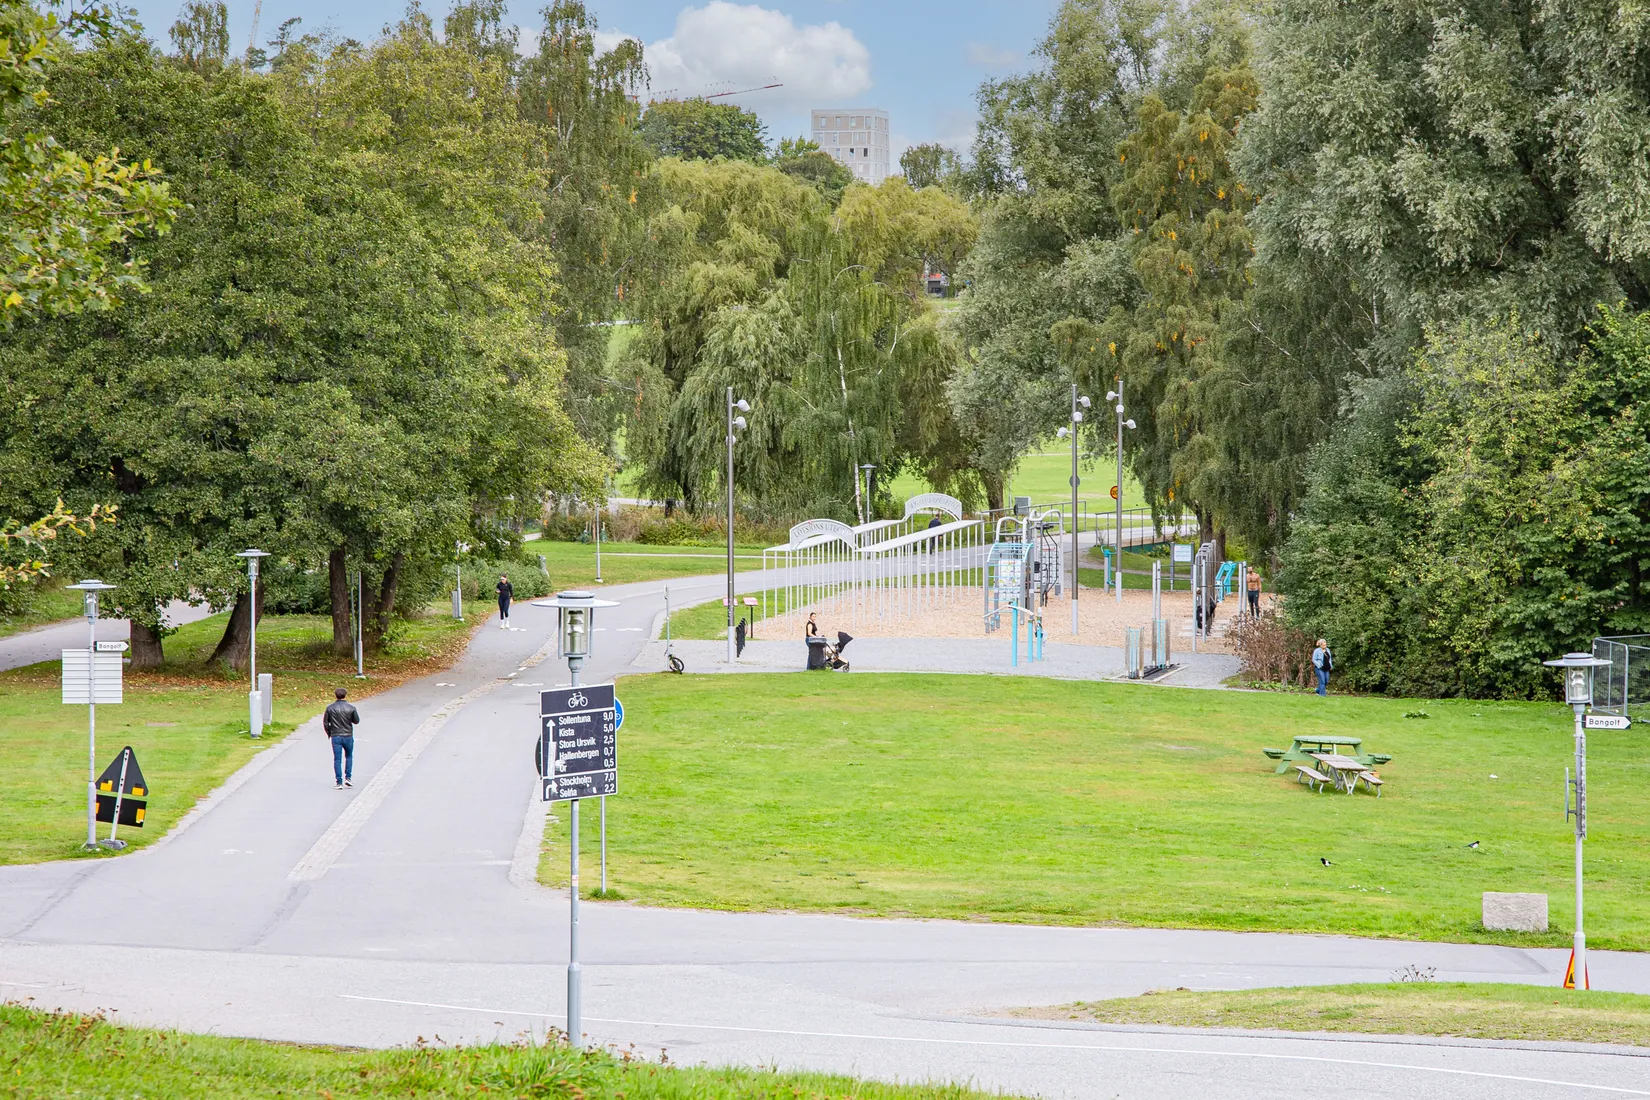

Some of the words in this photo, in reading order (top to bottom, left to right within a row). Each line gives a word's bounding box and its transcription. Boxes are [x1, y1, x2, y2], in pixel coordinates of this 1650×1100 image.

[559, 715, 591, 726] Sollentuna
[603, 712, 614, 722] 9,0
[1589, 718, 1620, 727] Bangolf
[559, 727, 575, 738] Kista
[603, 723, 614, 733] 5,0
[559, 739, 576, 750] Stora
[576, 736, 596, 748] Ursvik
[603, 735, 614, 745] 2,5
[559, 749, 600, 761] Hallenbergen
[603, 746, 614, 757] 0,7
[603, 758, 614, 768] 0,5
[559, 775, 592, 786] Stockholm
[604, 772, 615, 782] 7,0
[604, 783, 615, 793] 2,2
